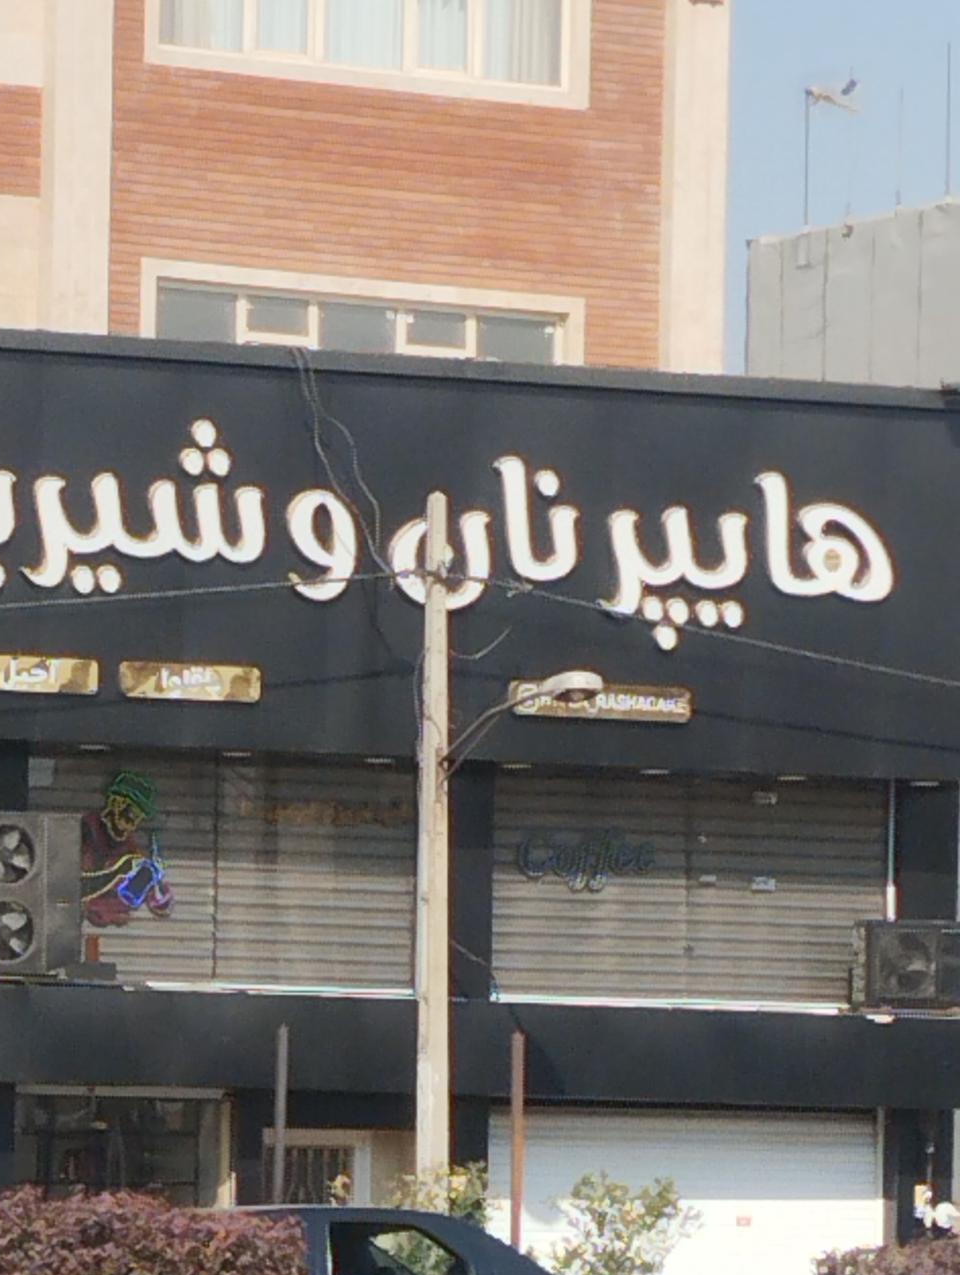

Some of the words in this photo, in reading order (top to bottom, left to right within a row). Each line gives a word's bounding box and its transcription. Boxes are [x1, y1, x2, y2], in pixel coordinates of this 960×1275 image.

[285, 488, 359, 602] و
[597, 470, 894, 650] هایپر
[2, 657, 58, 690] آجیل
[516, 830, 656, 892] Coffee
